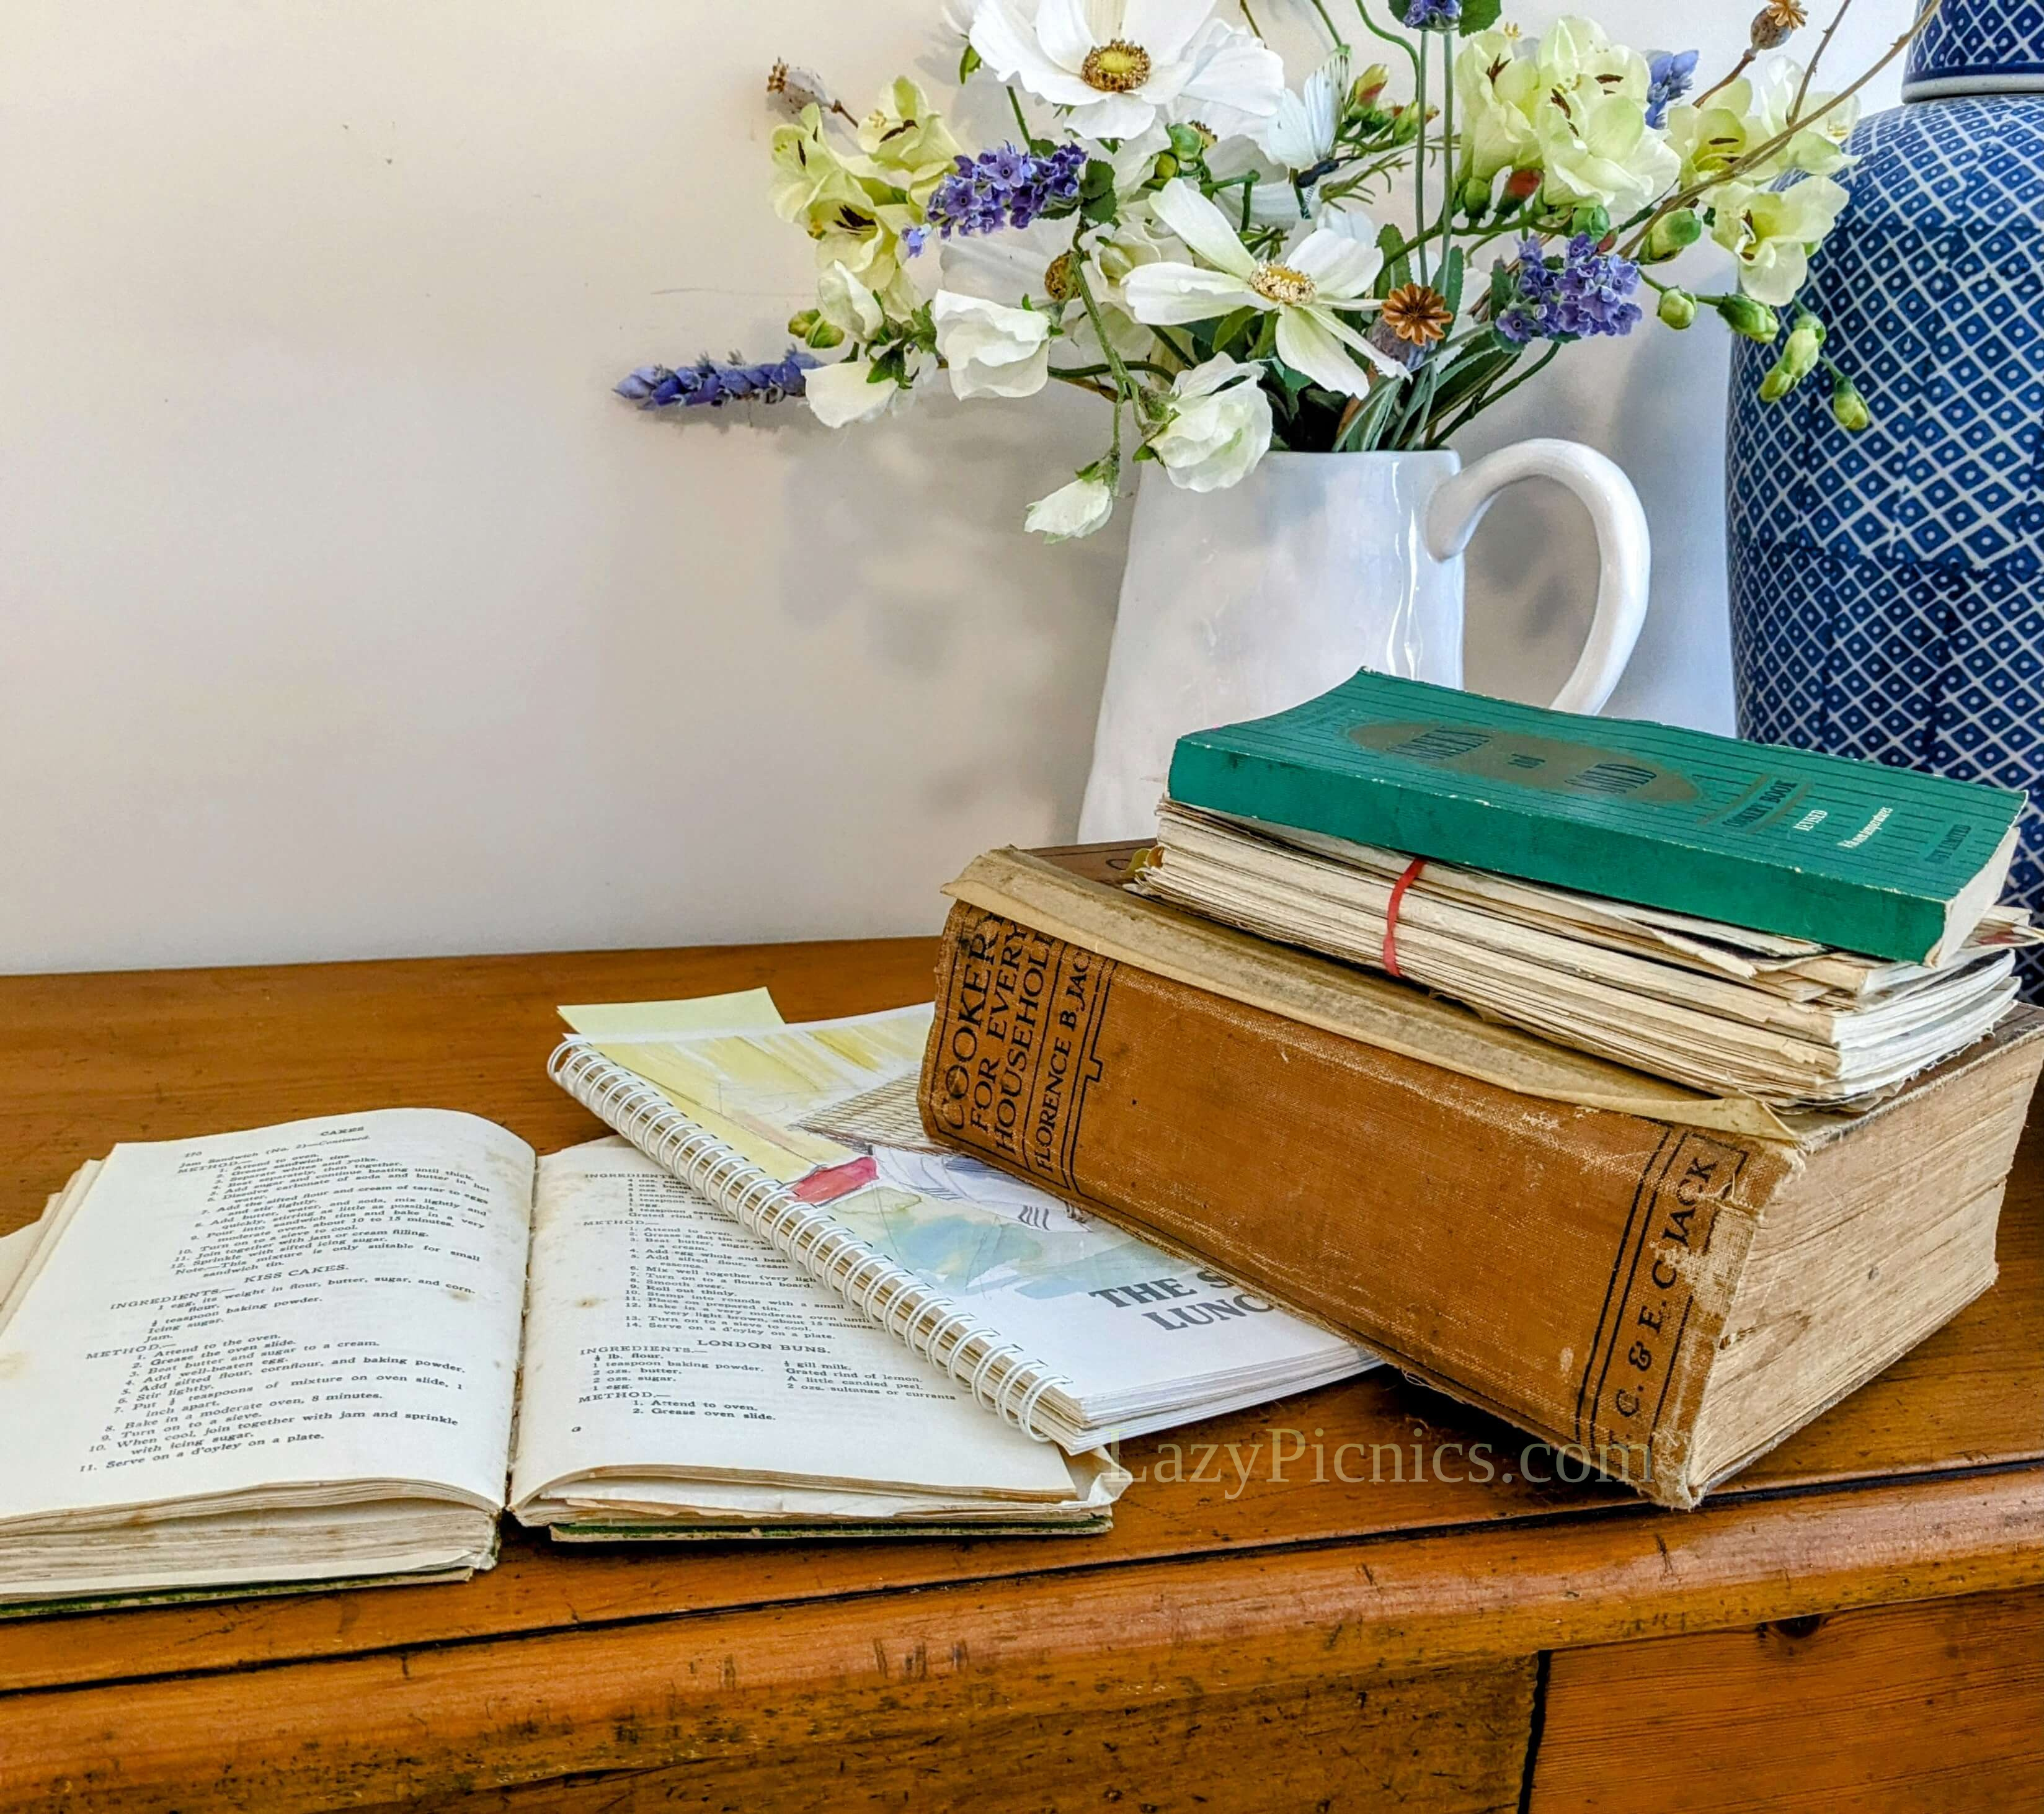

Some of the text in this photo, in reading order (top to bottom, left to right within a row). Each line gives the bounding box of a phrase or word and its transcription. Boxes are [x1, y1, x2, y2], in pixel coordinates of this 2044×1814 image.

[1759, 780, 1798, 803] BOOK
[970, 920, 1027, 1132] FOR EVERY
[1034, 1037, 1072, 1173] FLORENCE
[1066, 951, 1091, 1011] JAC
[244, 1265, 349, 1283] KISS CAKES.
[1629, 1341, 1652, 1372] &
[1661, 1157, 1718, 1246] JACK
[224, 1289, 265, 1299] weight
[1088, 1270, 1236, 1308] THE S
[166, 1311, 218, 1323] teaspoon
[226, 1303, 268, 1314] baking
[274, 1297, 322, 1307] powder.
[1141, 1292, 1276, 1331] LUNC
[148, 1325, 180, 1333] Icing
[696, 1340, 830, 1353] LONDON BUNS.
[140, 1382, 167, 1392] Add
[175, 1376, 211, 1386] sifted
[415, 1360, 465, 1373] powder.
[715, 1364, 763, 1372] powder.
[786, 1368, 827, 1376] Grated
[882, 1374, 923, 1382] lemon.
[132, 1402, 156, 1410] Put
[189, 1387, 253, 1401] teaspoons
[265, 1381, 278, 1389] of
[291, 1377, 342, 1385] mixture
[906, 1392, 956, 1400] currants
[125, 1420, 158, 1429] Bake
[200, 1403, 262, 1417] moderate
[146, 1408, 174, 1417] inch
[182, 1401, 220, 1411] apart.
[117, 1438, 157, 1448] When
[203, 1426, 230, 1436] join
[238, 1417, 295, 1429] together
[303, 1413, 332, 1421] with
[339, 1411, 365, 1419] jam
[405, 1413, 458, 1425] sprinkle
[106, 1458, 145, 1469] Serve
[287, 1434, 324, 1443] plate.
[131, 1432, 254, 1455] with icing sugar.
